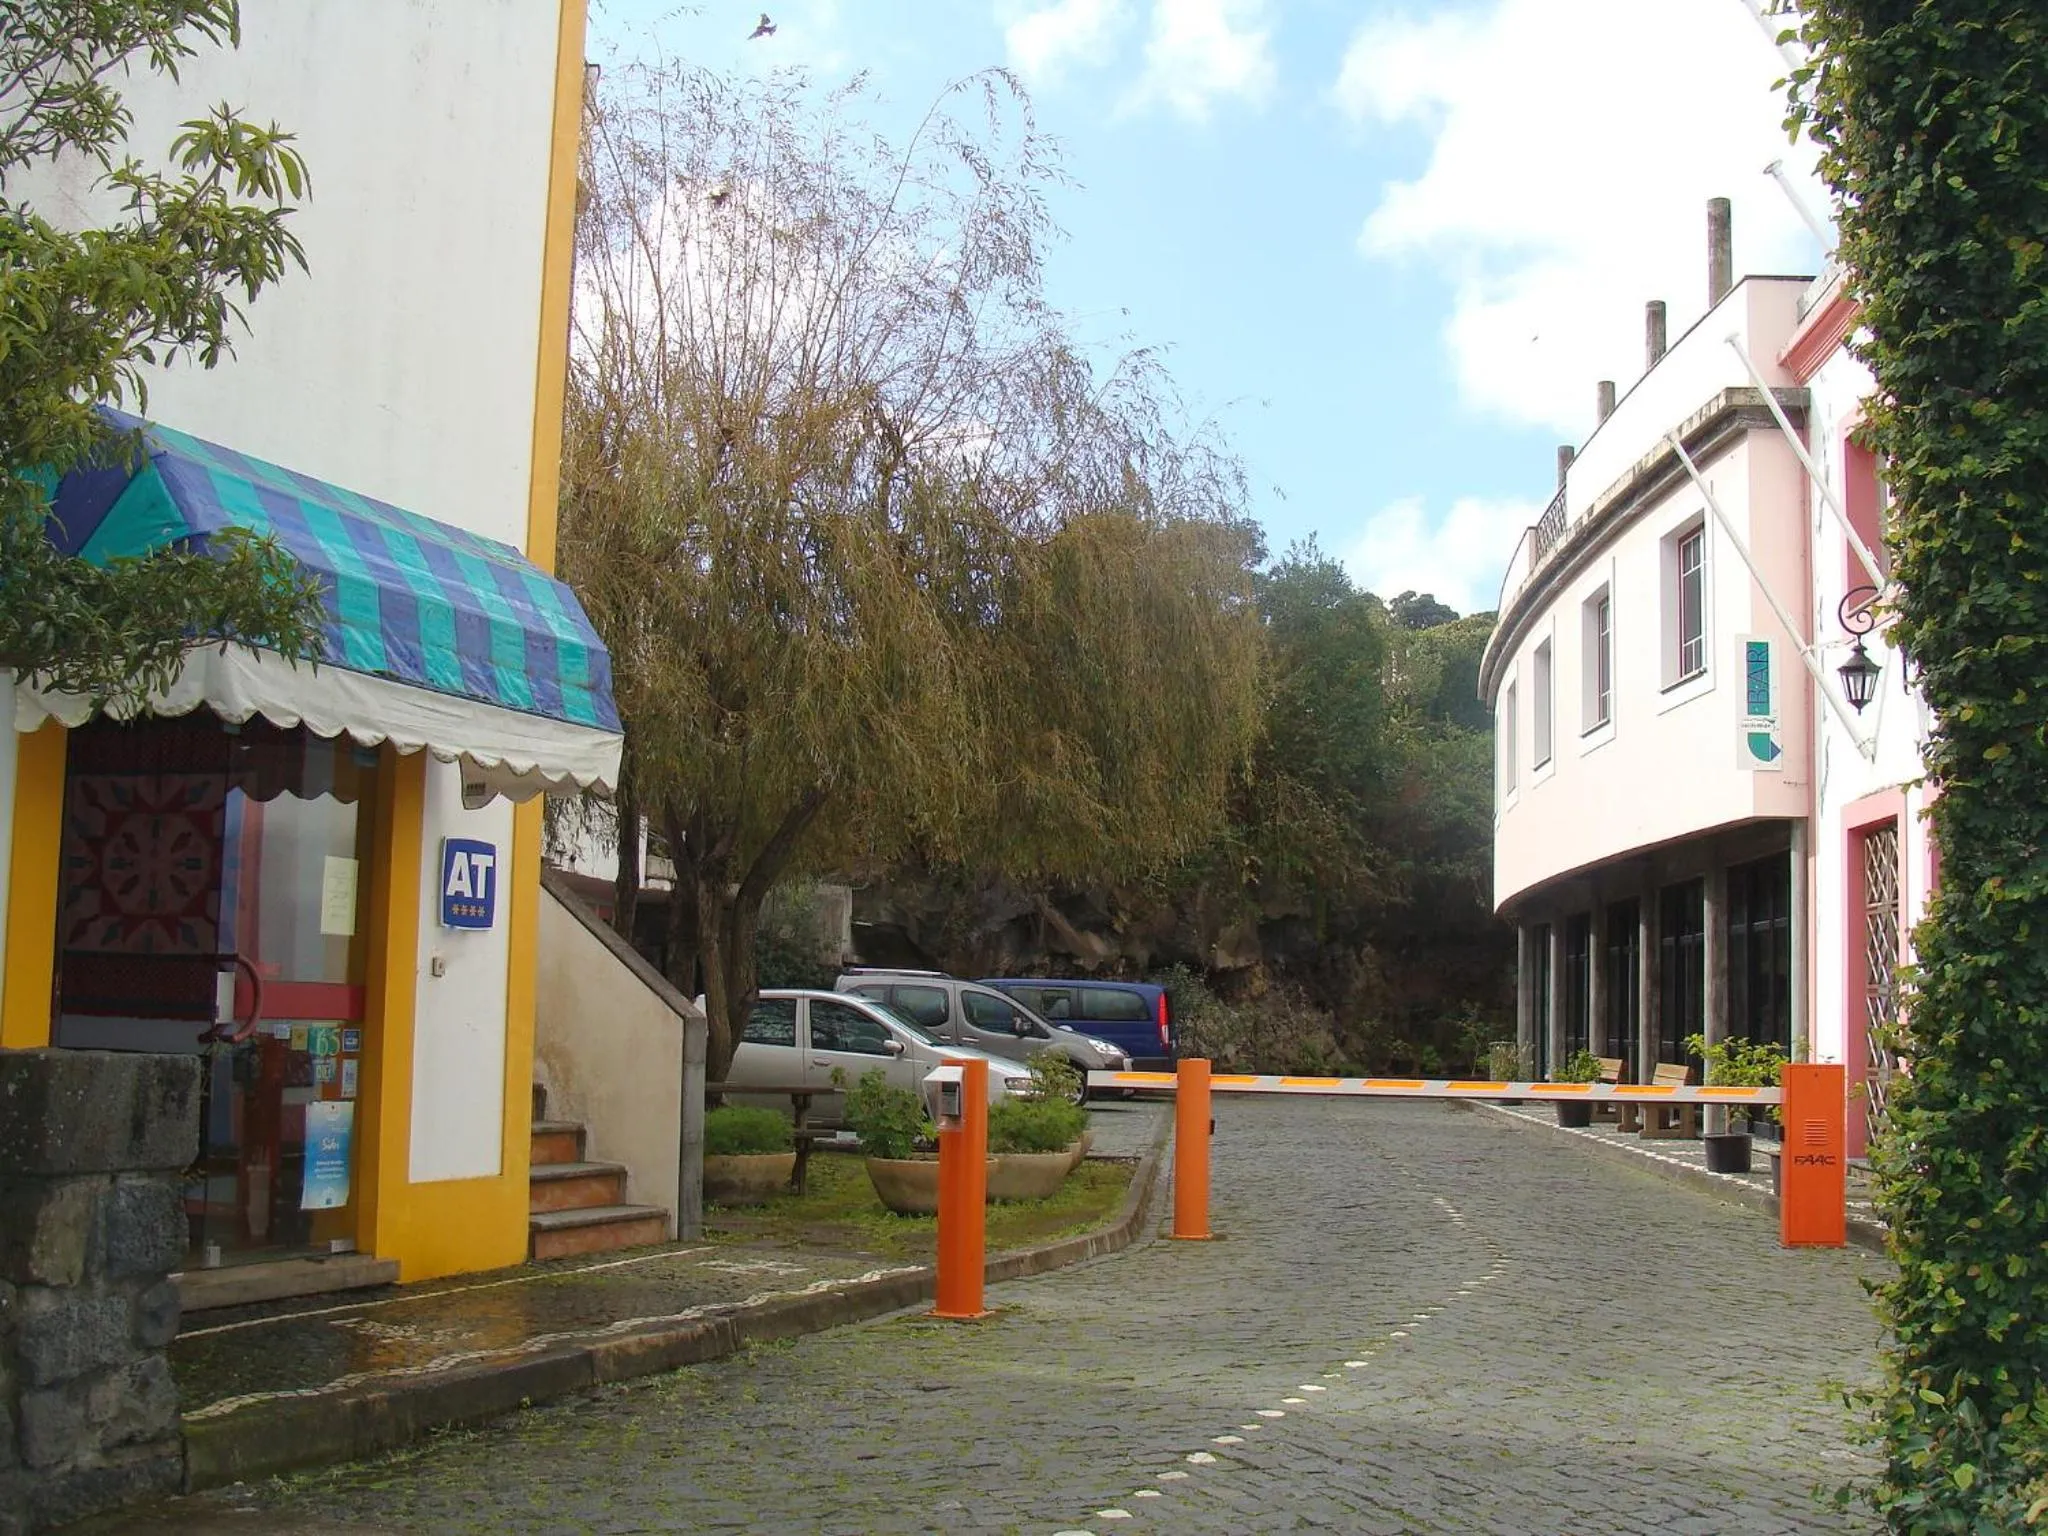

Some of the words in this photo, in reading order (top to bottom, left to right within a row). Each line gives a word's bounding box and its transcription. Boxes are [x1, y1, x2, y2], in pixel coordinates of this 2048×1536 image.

[1747, 647, 1768, 704] BAR
[446, 852, 494, 898] AT
[1793, 1154, 1836, 1165] FAAC
